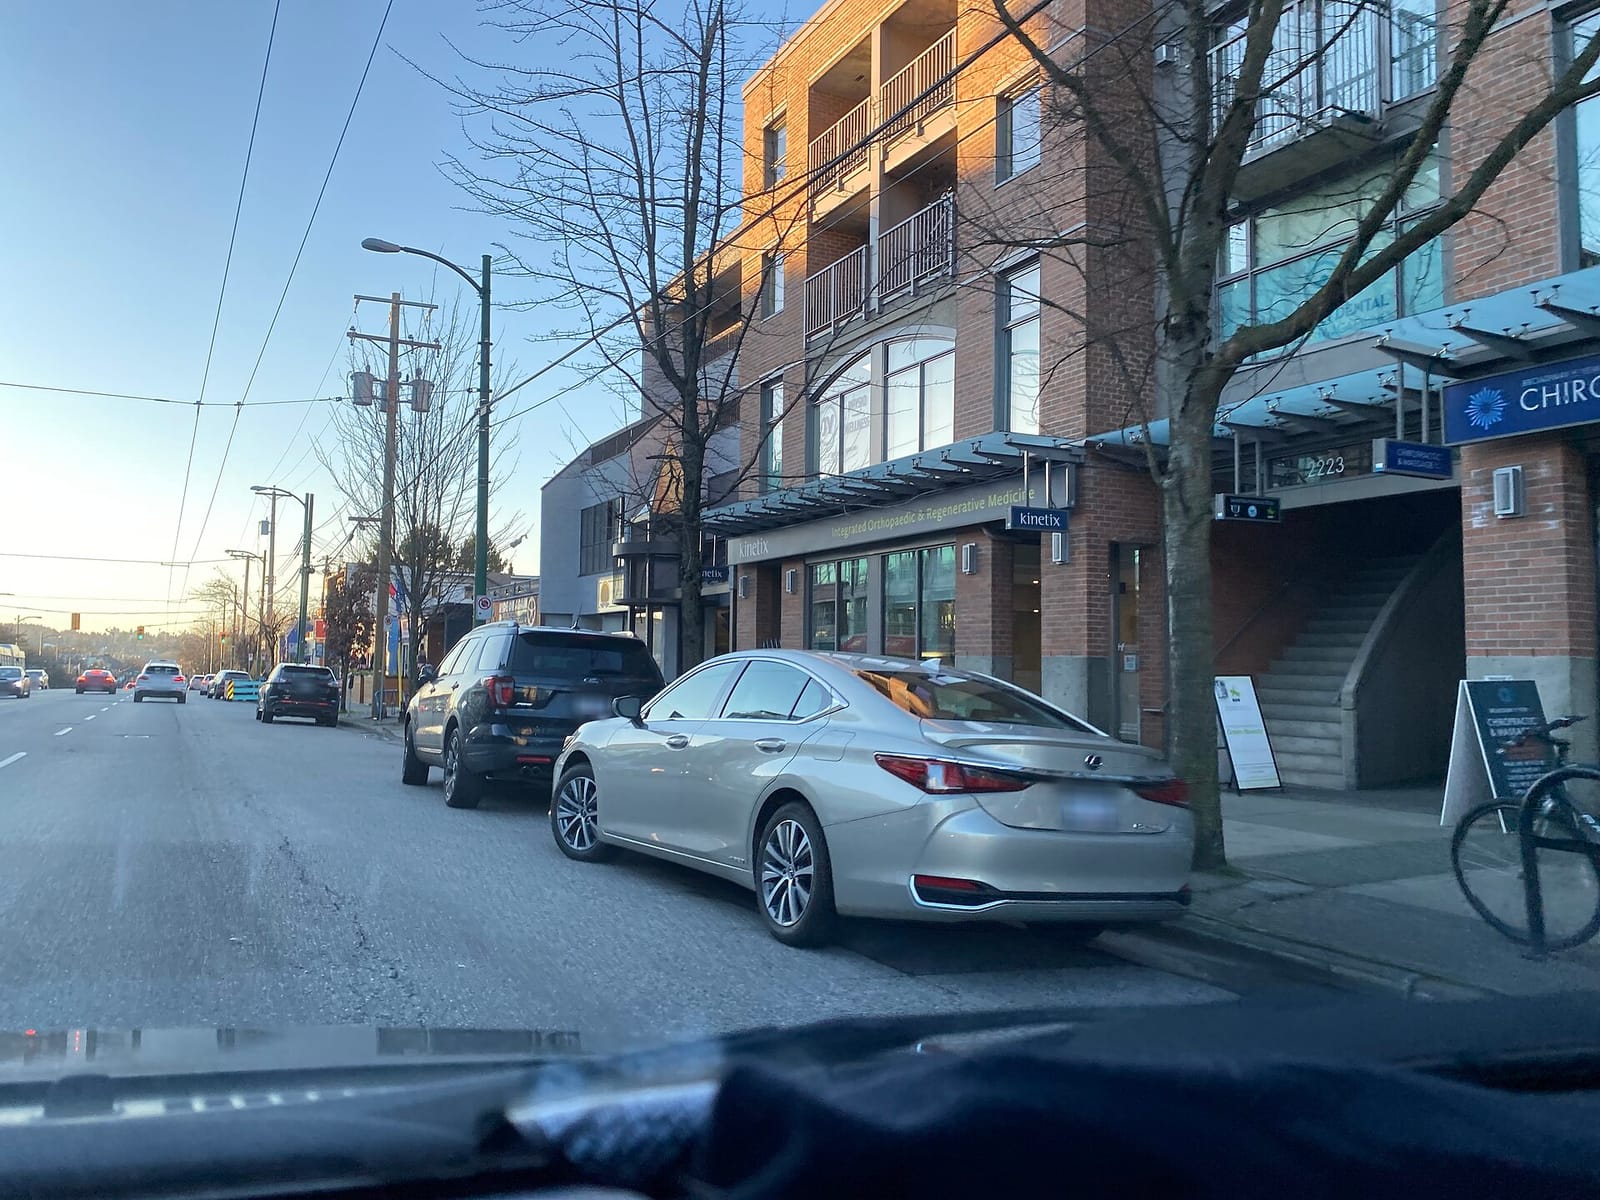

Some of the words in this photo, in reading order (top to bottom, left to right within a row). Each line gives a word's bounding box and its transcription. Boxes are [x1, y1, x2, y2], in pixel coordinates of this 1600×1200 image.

[1335, 294, 1389, 319] DENTAL
[1307, 456, 1345, 478] 2223
[831, 521, 867, 539] Integrated
[867, 511, 916, 530] Orthopaedic
[918, 509, 925, 521] &
[926, 498, 985, 521] Regenerative
[988, 487, 1036, 508] Medicine
[1020, 512, 1060, 527] kinetix
[739, 538, 769, 558] kinetix
[701, 569, 723, 578] netix
